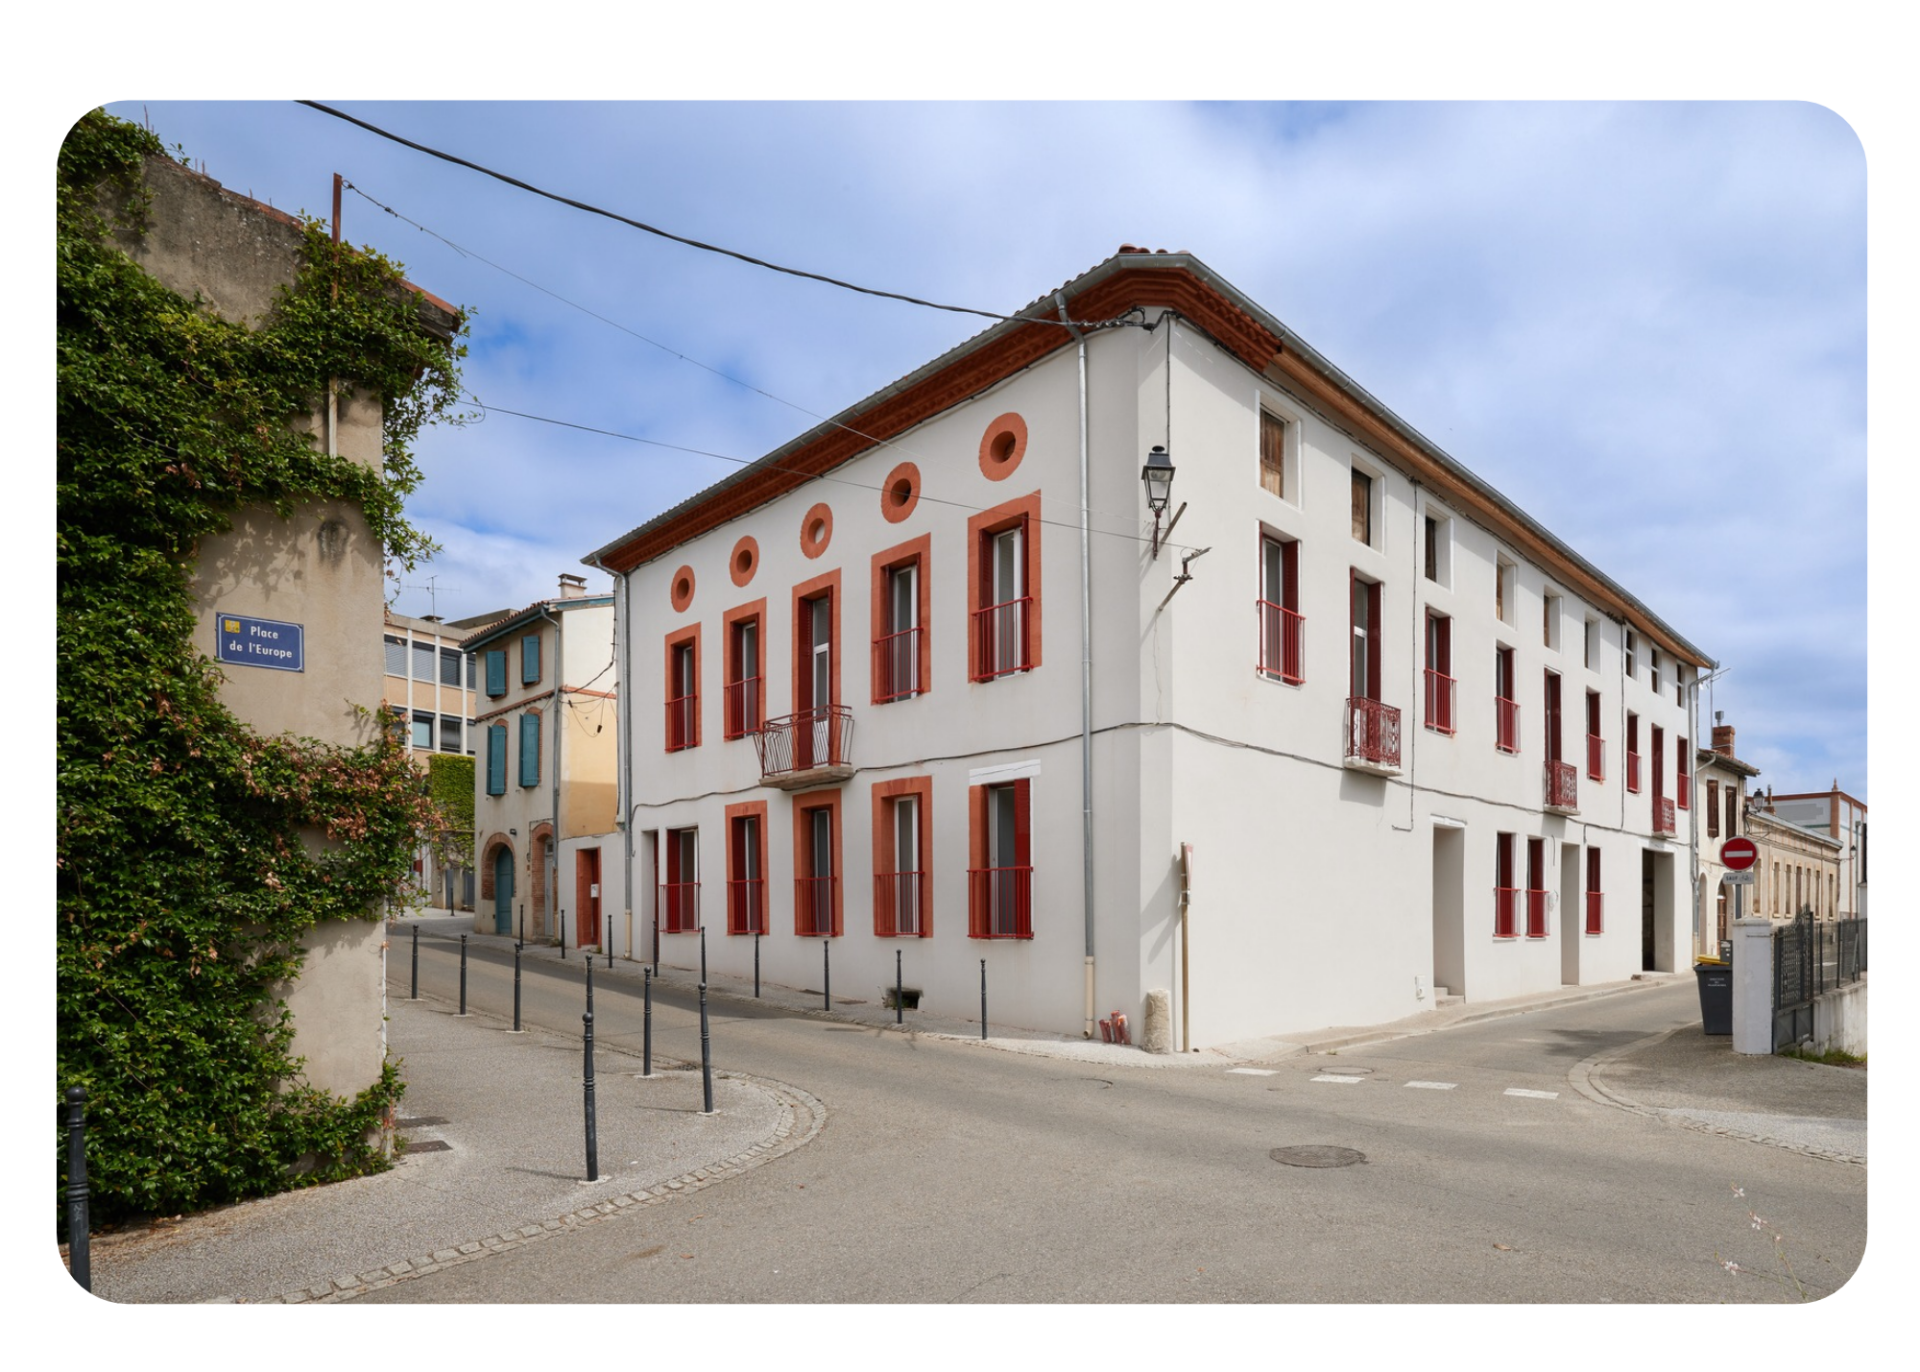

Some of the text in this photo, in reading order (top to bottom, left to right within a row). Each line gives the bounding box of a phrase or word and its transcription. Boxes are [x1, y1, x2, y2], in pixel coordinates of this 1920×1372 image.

[250, 626, 279, 639] Place
[229, 640, 292, 659] de l'Europe
